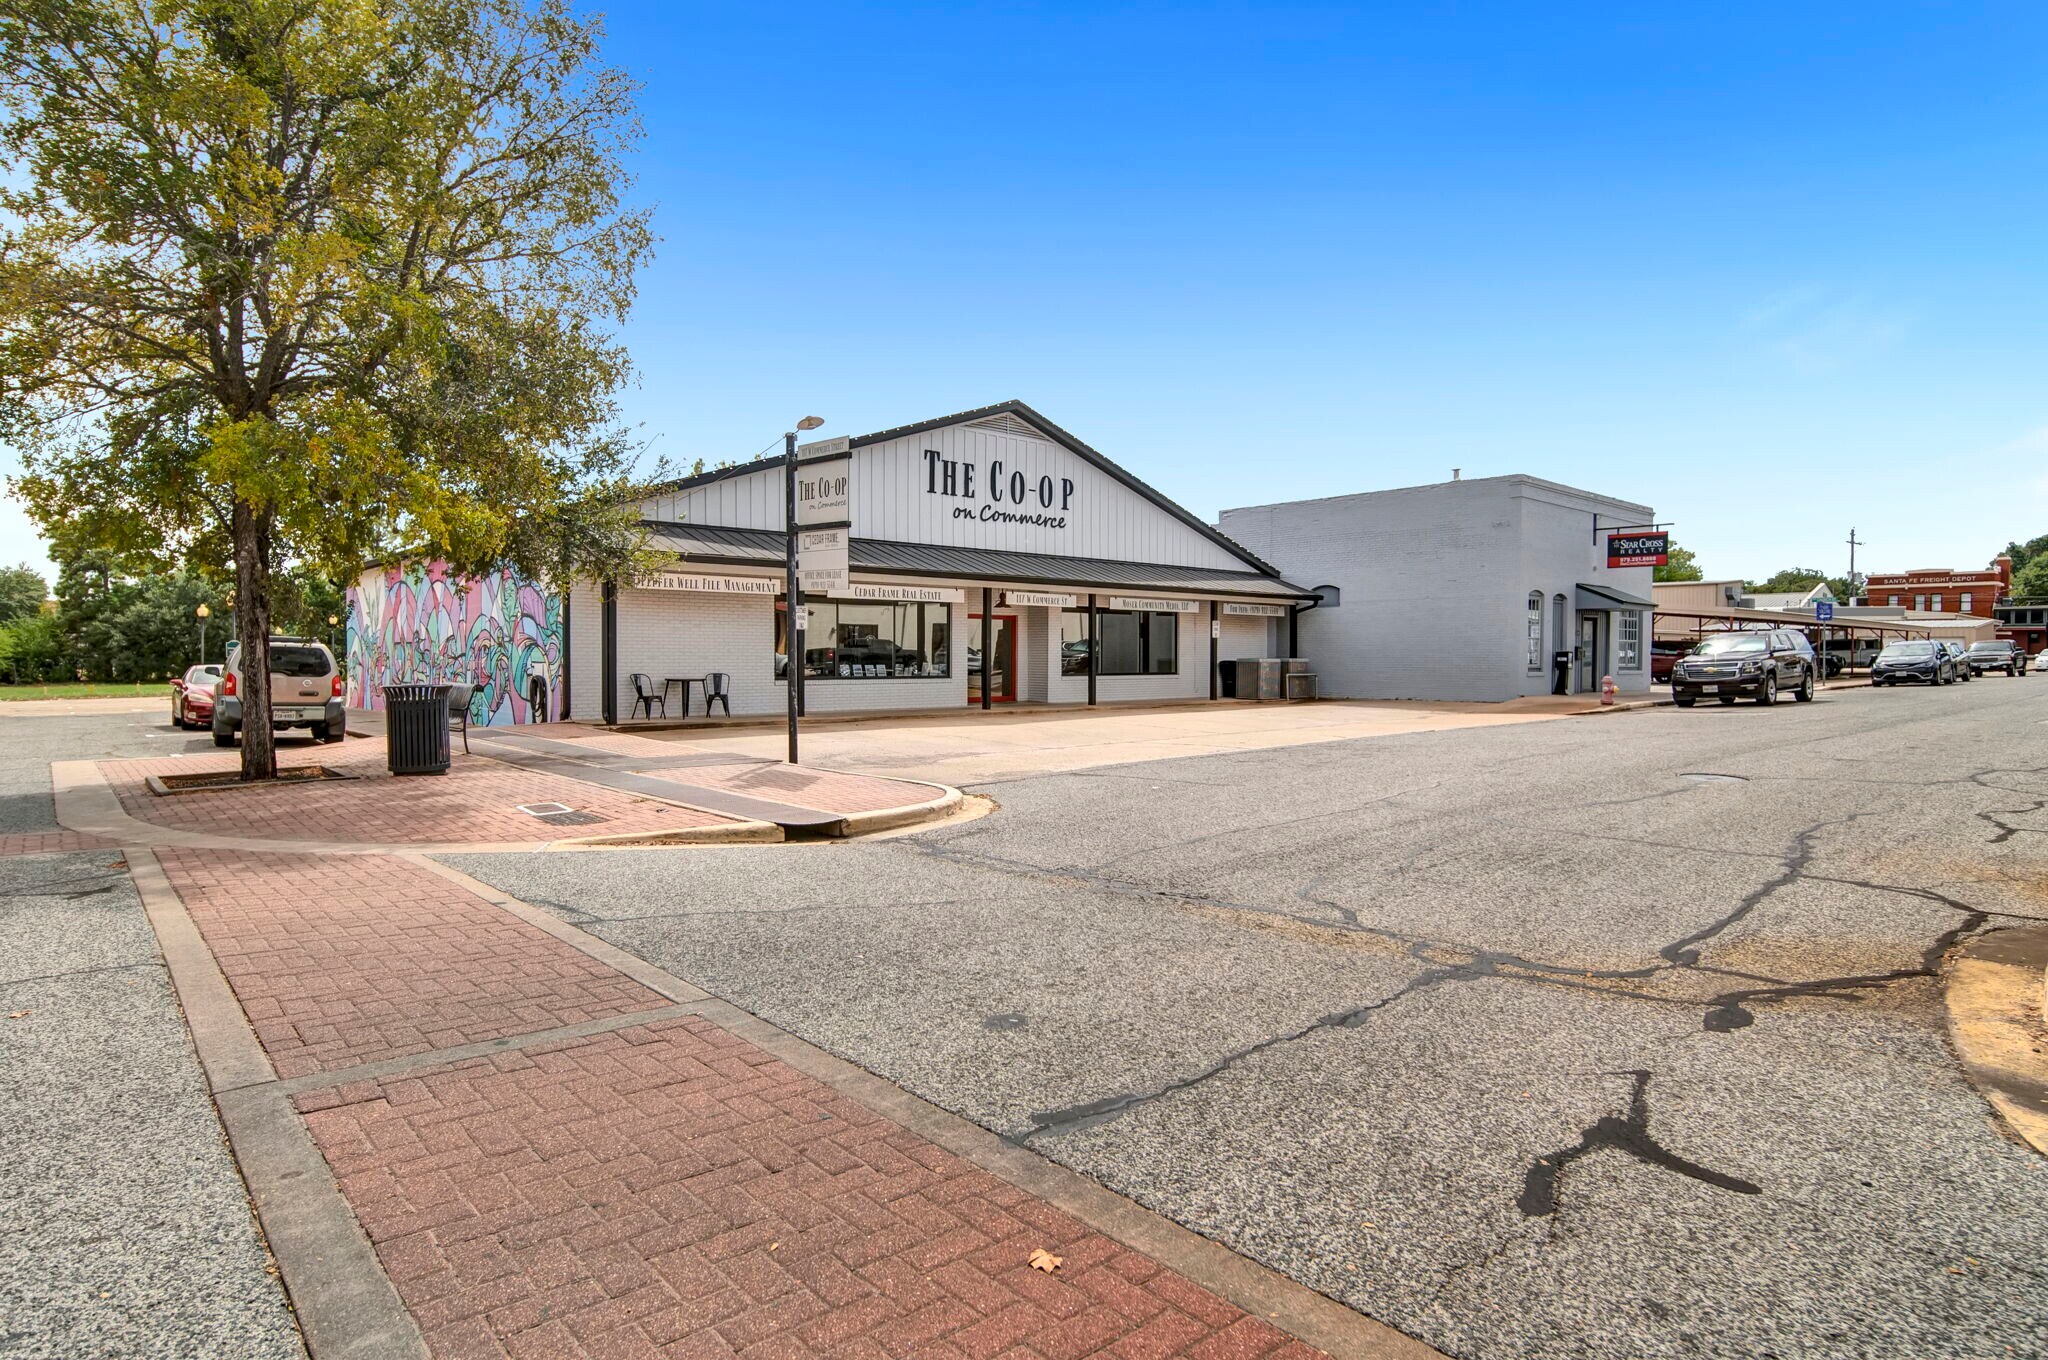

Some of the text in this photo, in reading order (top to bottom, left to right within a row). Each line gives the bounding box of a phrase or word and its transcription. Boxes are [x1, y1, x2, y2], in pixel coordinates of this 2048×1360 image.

[924, 449, 1074, 510] THE CO-OP
[799, 477, 847, 501] THE CO-OP
[953, 504, 1066, 529] on Commerce
[825, 532, 840, 543] FRAME
[1620, 538, 1664, 549] STAR CROSS
[678, 577, 699, 589] WELL
[703, 578, 721, 590] FILE
[724, 580, 777, 593] MANAGEMENT
[1883, 577, 1907, 585] SANTA
[1920, 576, 1950, 584] FREIGHT
[1952, 575, 1977, 583] DEPOT
[854, 586, 941, 600] CEDAR FRAME REAL ESTATE
[1032, 595, 1059, 605] COMMERCE
[1061, 597, 1068, 606] ST
[1139, 600, 1165, 610] COMMUNITY
